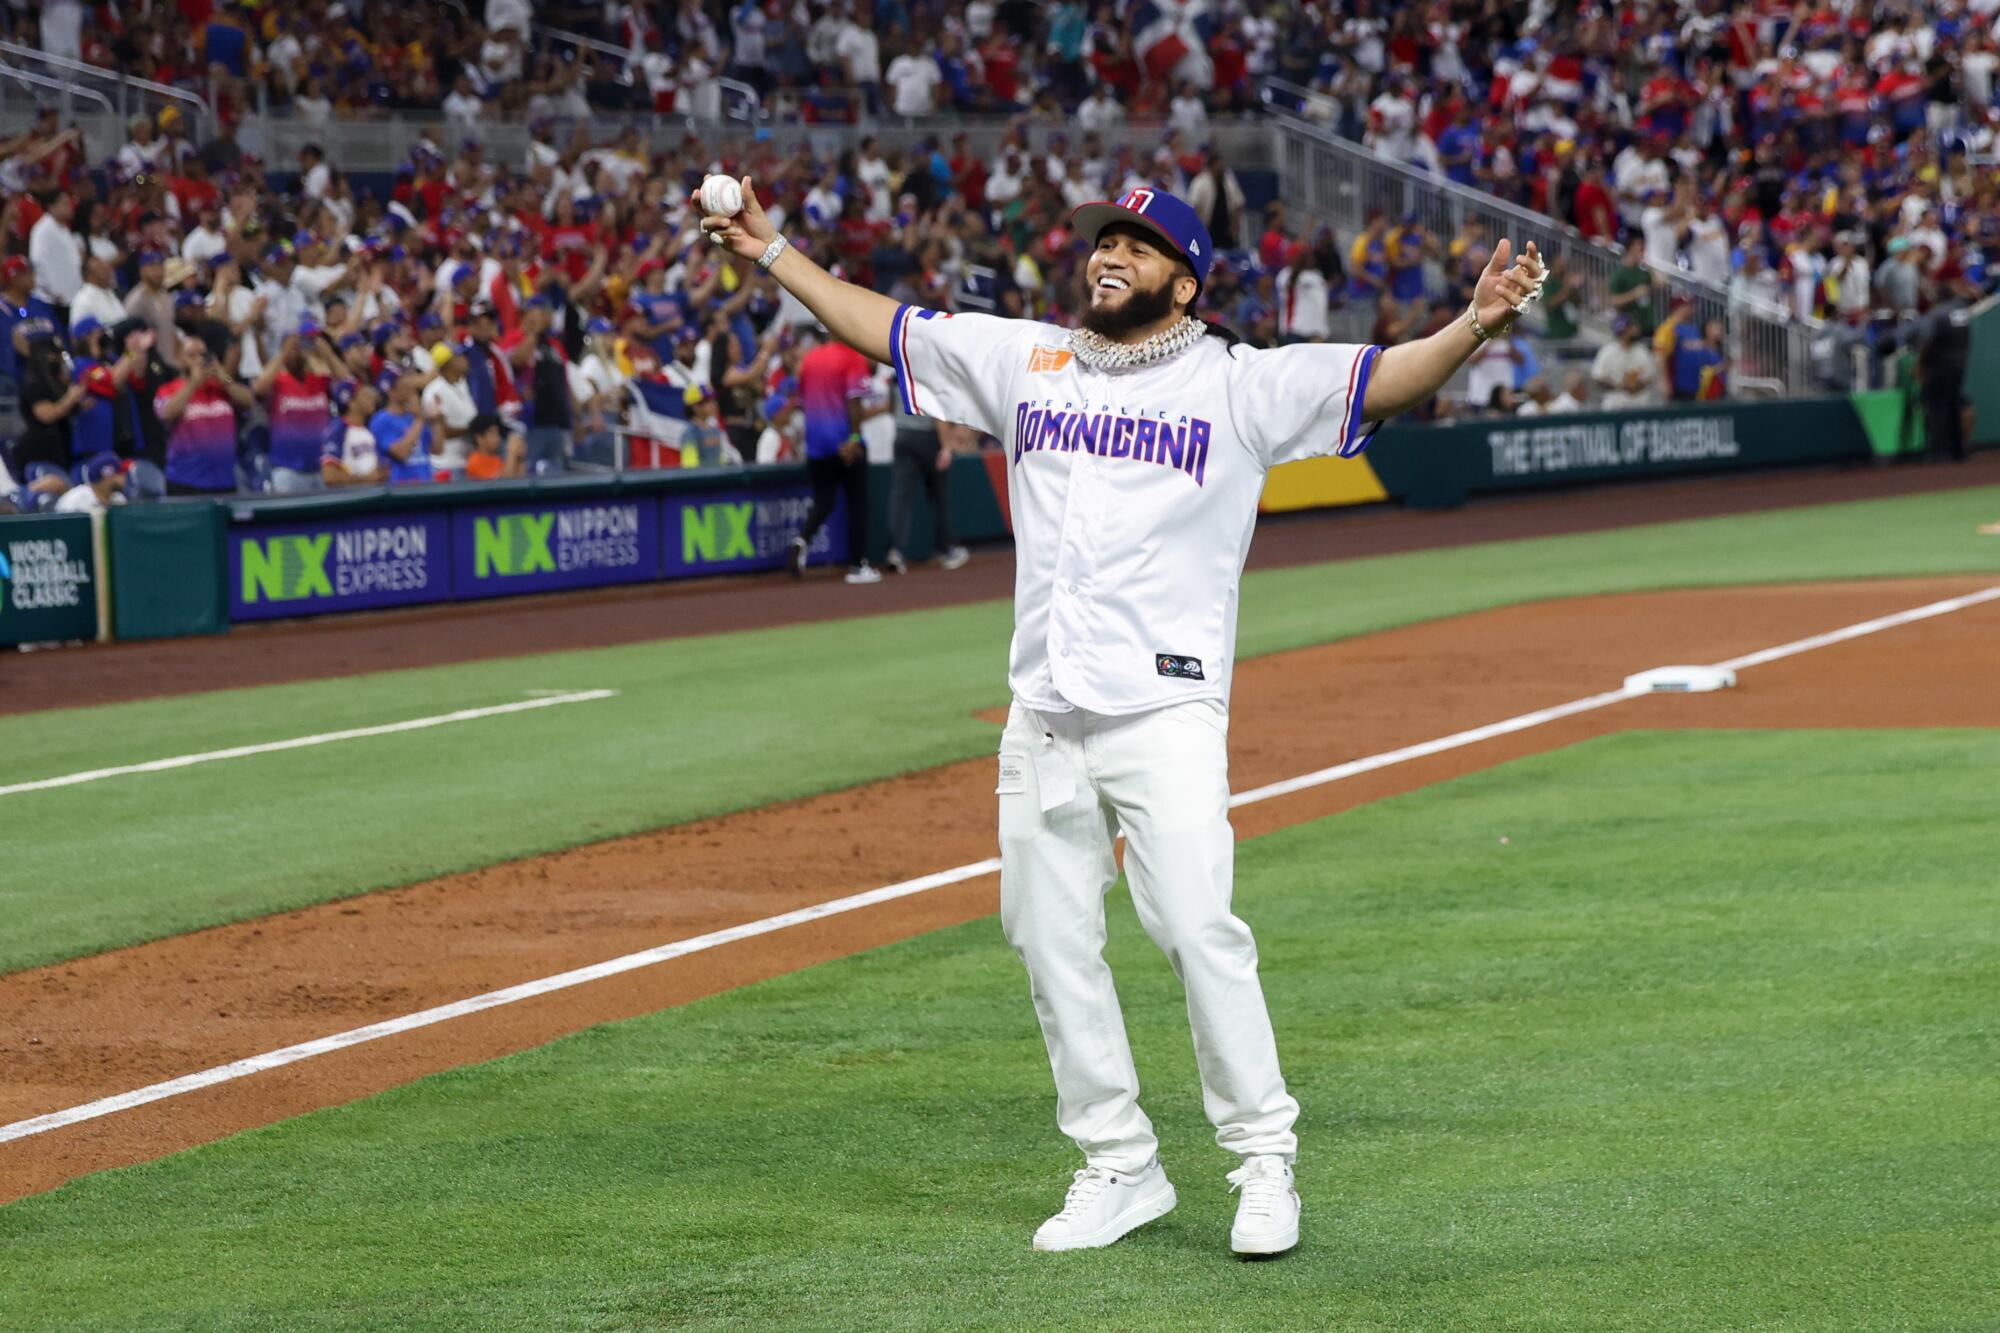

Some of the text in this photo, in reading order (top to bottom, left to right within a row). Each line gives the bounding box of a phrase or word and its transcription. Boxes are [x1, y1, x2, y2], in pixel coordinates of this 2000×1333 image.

[1015, 401, 1212, 489] DOMINICANA
[1488, 416, 1740, 476] THE FESTIVAL OF BASEBALL
[558, 505, 639, 540] NIPPON
[681, 501, 756, 564] NX
[8, 539, 69, 562] WORLD
[336, 524, 427, 564] NIPPON
[473, 511, 557, 579] NX
[558, 535, 640, 572] EXPRESS
[12, 558, 91, 584] BASEBALL
[241, 532, 335, 604] NX
[336, 557, 428, 596] EXPRESS
[12, 582, 80, 610] CLASSIC
